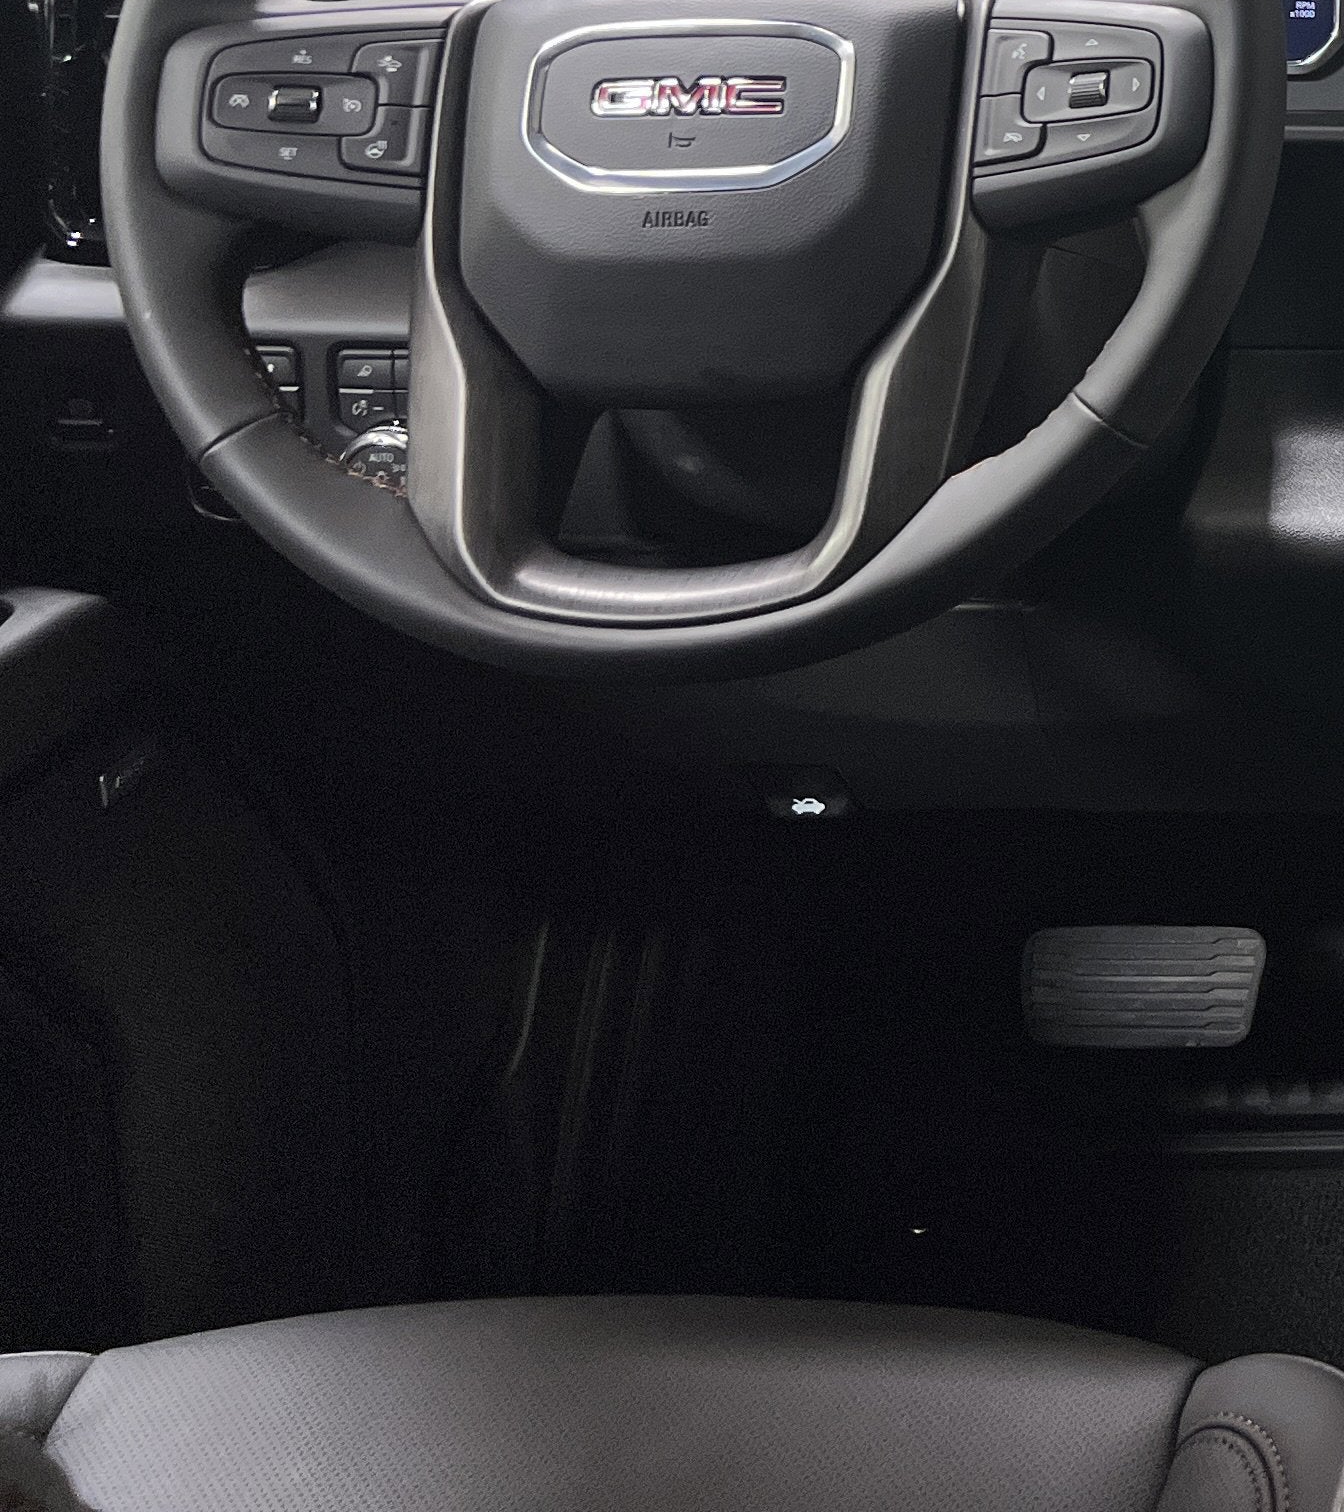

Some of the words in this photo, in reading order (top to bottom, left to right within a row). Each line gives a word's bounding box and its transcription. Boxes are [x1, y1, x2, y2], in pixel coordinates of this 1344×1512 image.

[1295, 0, 1316, 10] RPM
[590, 75, 787, 117] GMC
[641, 210, 711, 229] AIRBAG
[368, 452, 395, 463] AUTO
